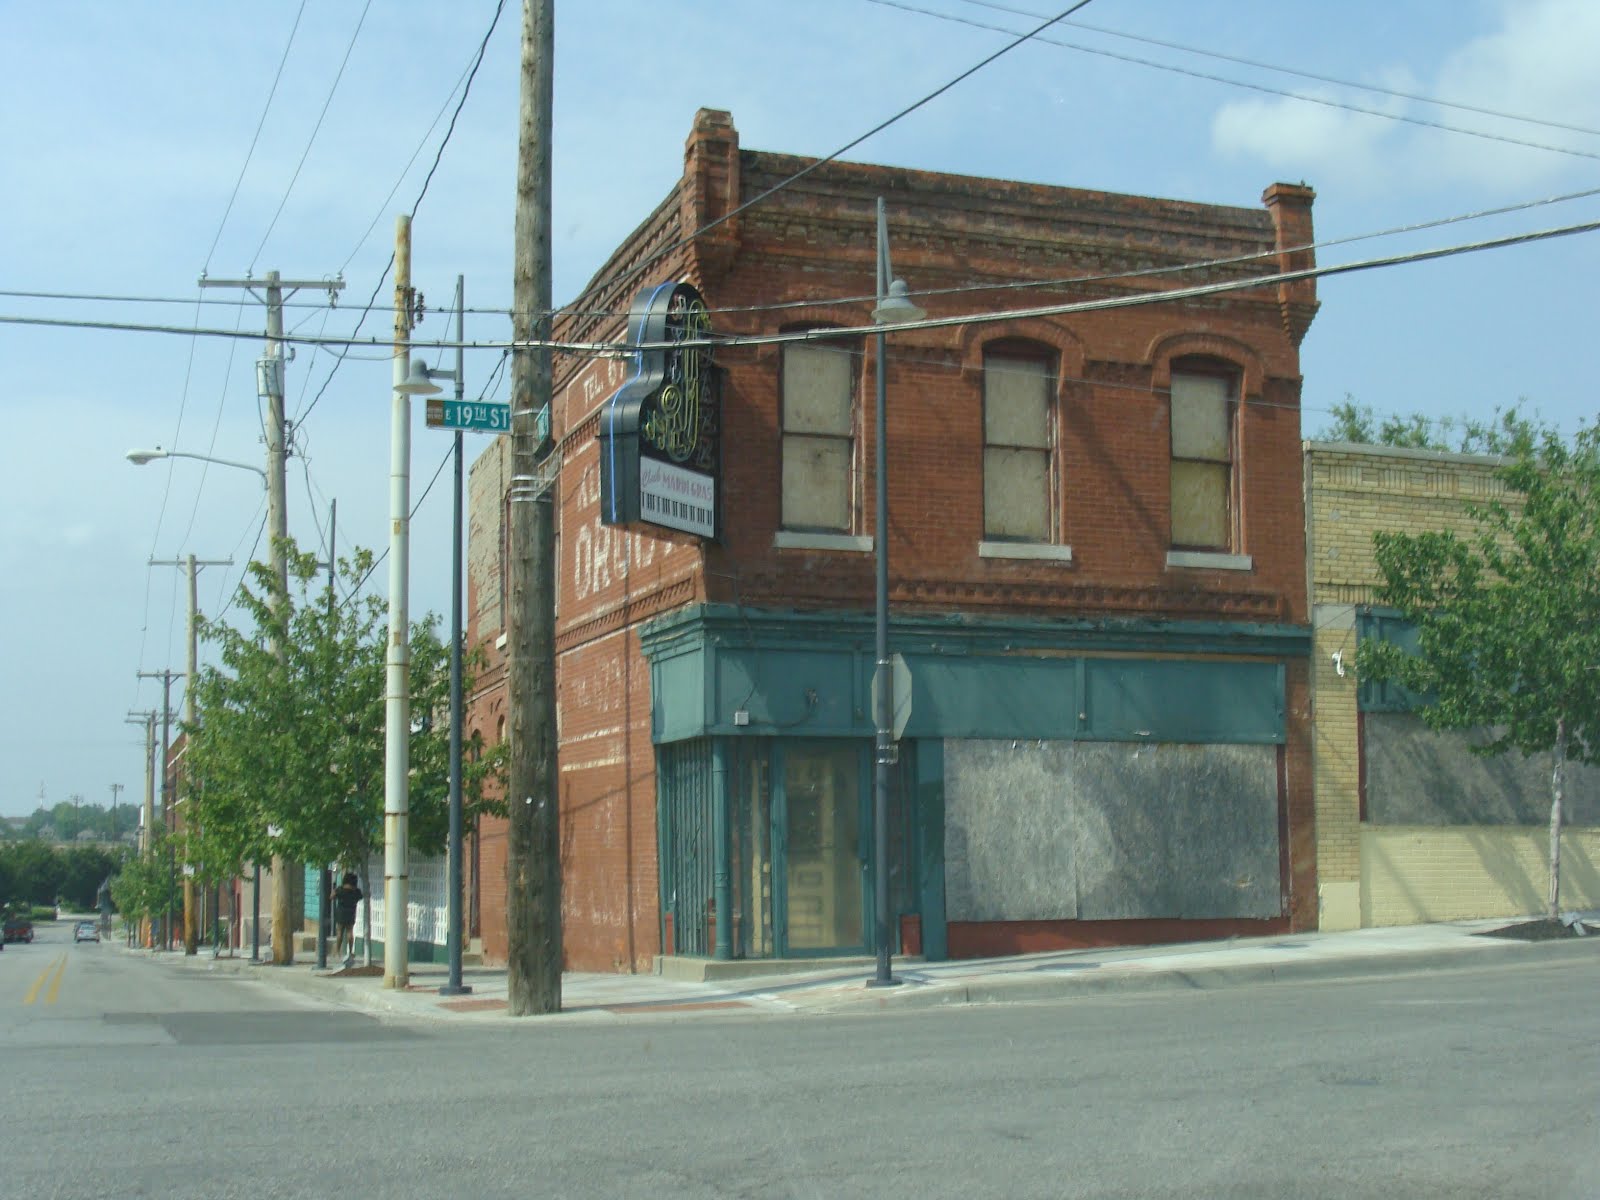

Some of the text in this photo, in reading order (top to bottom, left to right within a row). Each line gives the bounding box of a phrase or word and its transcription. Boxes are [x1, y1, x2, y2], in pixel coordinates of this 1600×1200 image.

[445, 408, 452, 420] E
[456, 405, 487, 426] 19TH
[490, 407, 510, 429] ST
[662, 472, 690, 496] MARDI
[691, 481, 713, 502] GRAS
